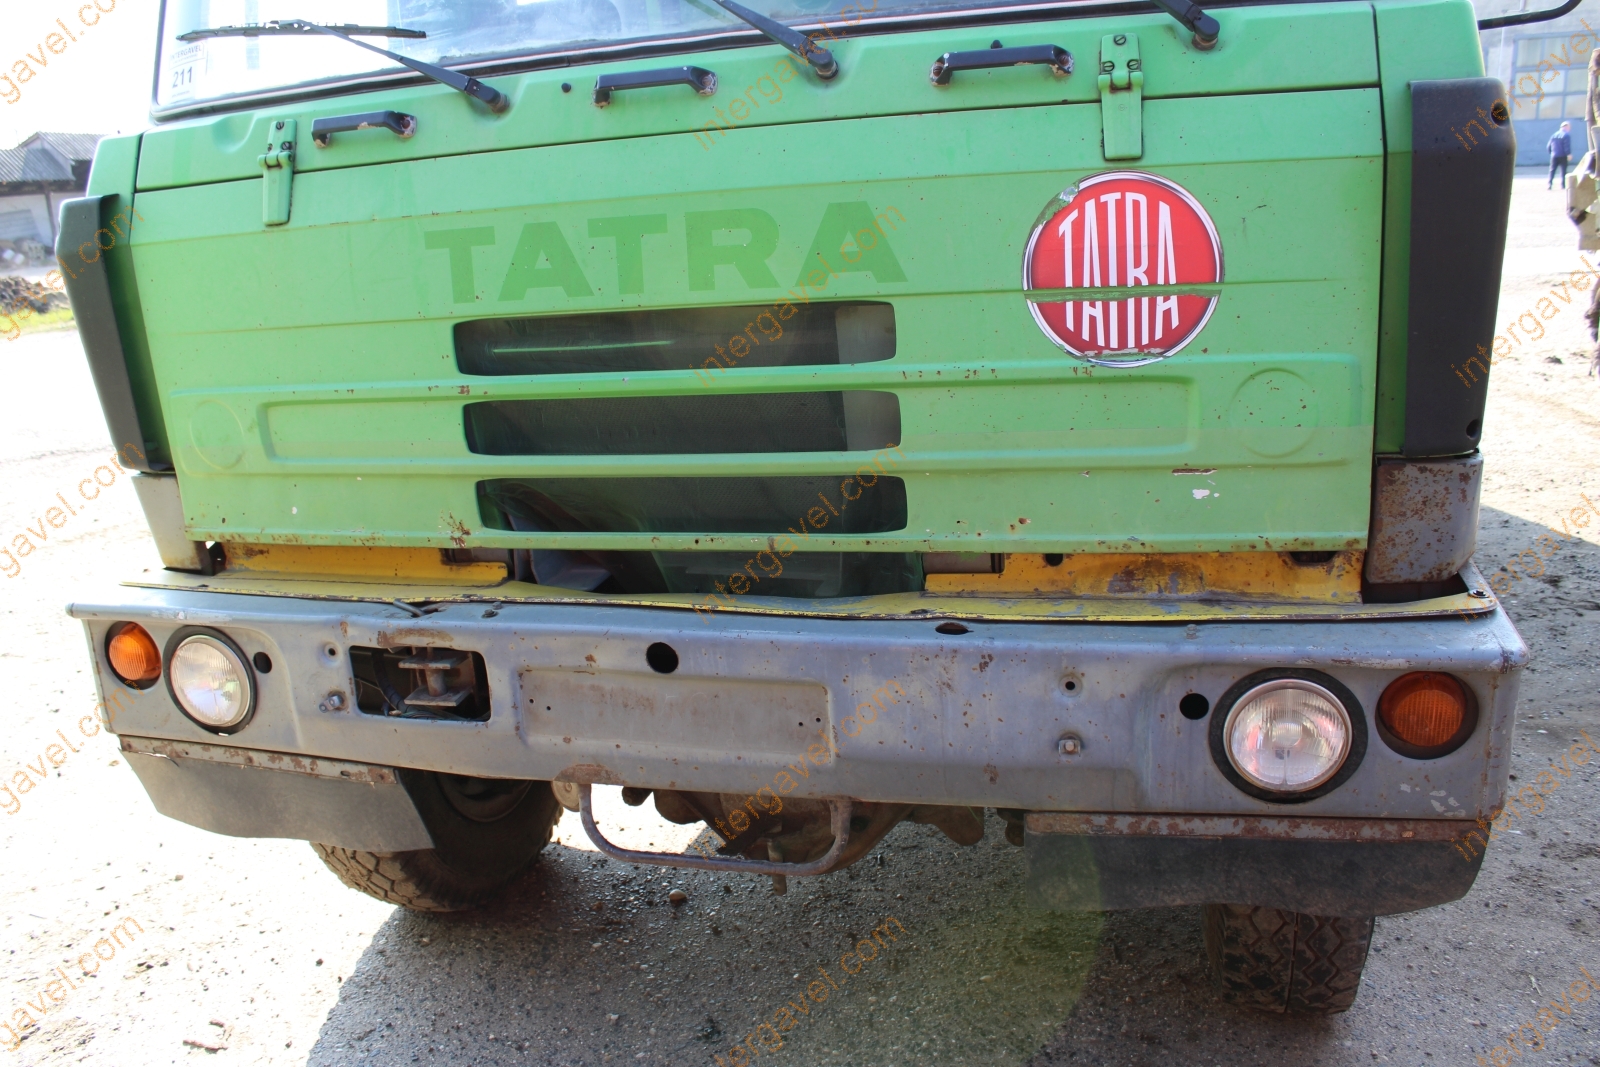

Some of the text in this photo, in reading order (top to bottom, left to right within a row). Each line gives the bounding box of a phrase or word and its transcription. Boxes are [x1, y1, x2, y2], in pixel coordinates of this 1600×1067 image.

[172, 66, 193, 89] 211
[424, 201, 909, 304] TATRA
[1058, 191, 1180, 349] TATRA
